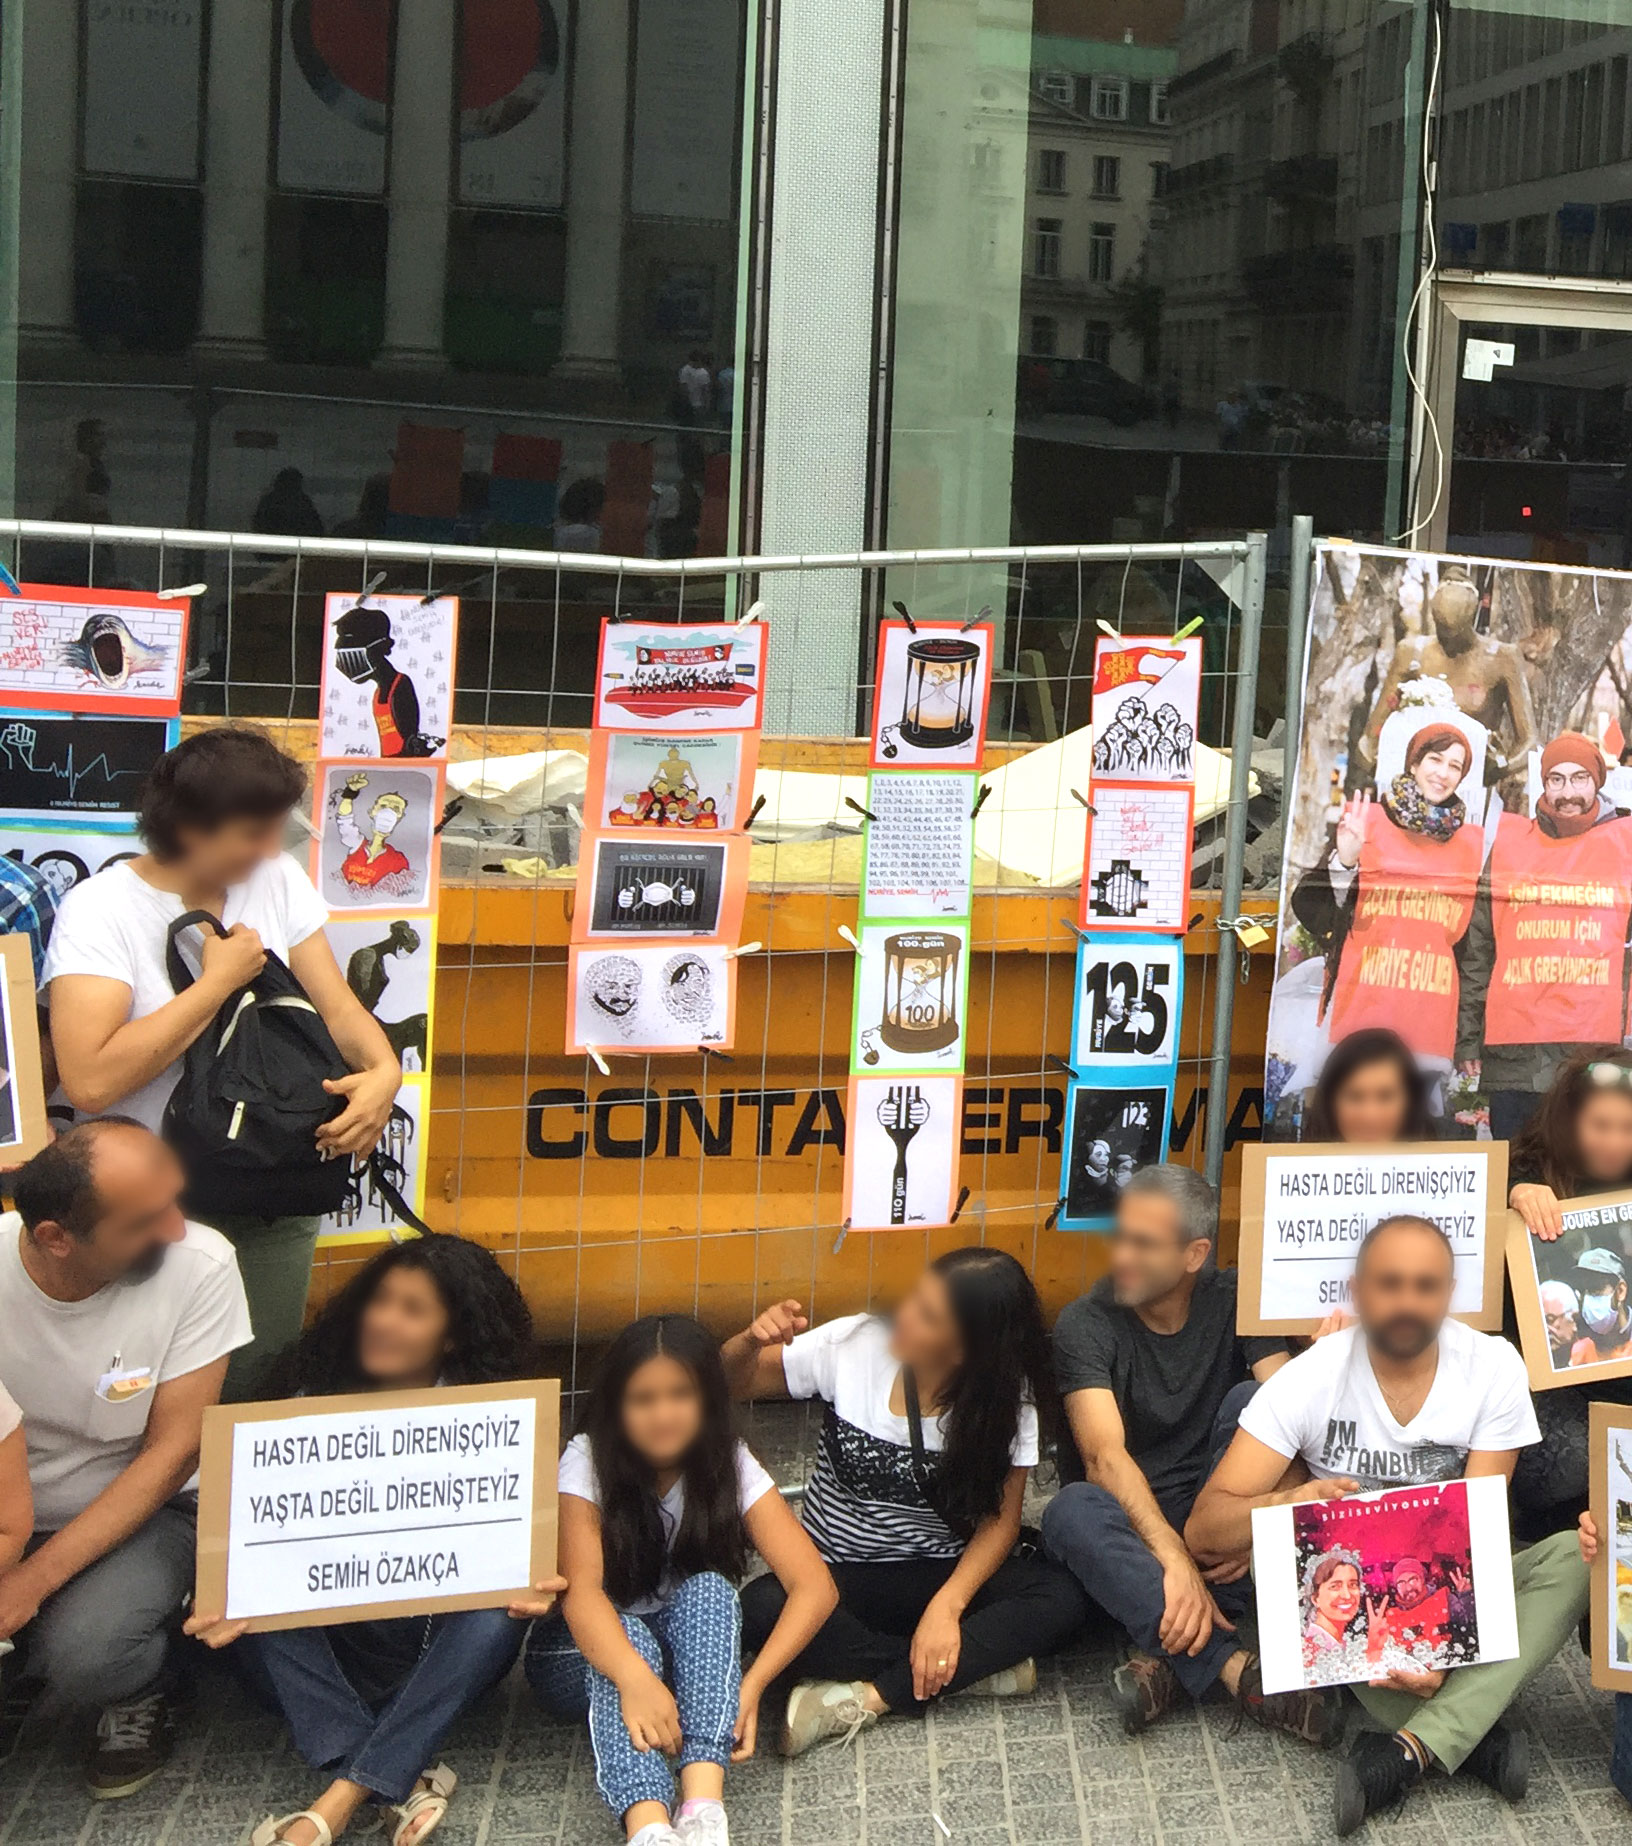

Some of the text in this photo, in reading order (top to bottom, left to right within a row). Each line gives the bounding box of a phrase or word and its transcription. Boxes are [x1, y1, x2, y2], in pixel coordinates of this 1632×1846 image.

[1539, 880, 1614, 908] EKMEĞİM
[1516, 914, 1602, 945] ONURUM İÇİN
[1359, 938, 1410, 989] NURİYE
[1502, 956, 1533, 991] AÇLIK
[905, 1005, 935, 1023] 100
[1086, 961, 1170, 1055] 125
[526, 1086, 1064, 1158] CONTAER
[893, 1177, 906, 1218] 110 gün
[1279, 1164, 1476, 1200] HASTA DEĞİL DİRENİŞÇİYİZ
[1277, 1218, 1325, 1249] YAŞTA
[1561, 1210, 1600, 1231] JOURS
[1600, 1205, 1618, 1225] EN
[253, 1413, 521, 1468] HASTA DEĞİL DİRENİŞÇİYİZ
[250, 1467, 520, 1528] YAŞTA DEĞİL DİRENİŞTEYİZ
[307, 1551, 459, 1592] SEMİH ÖZAKÇA
